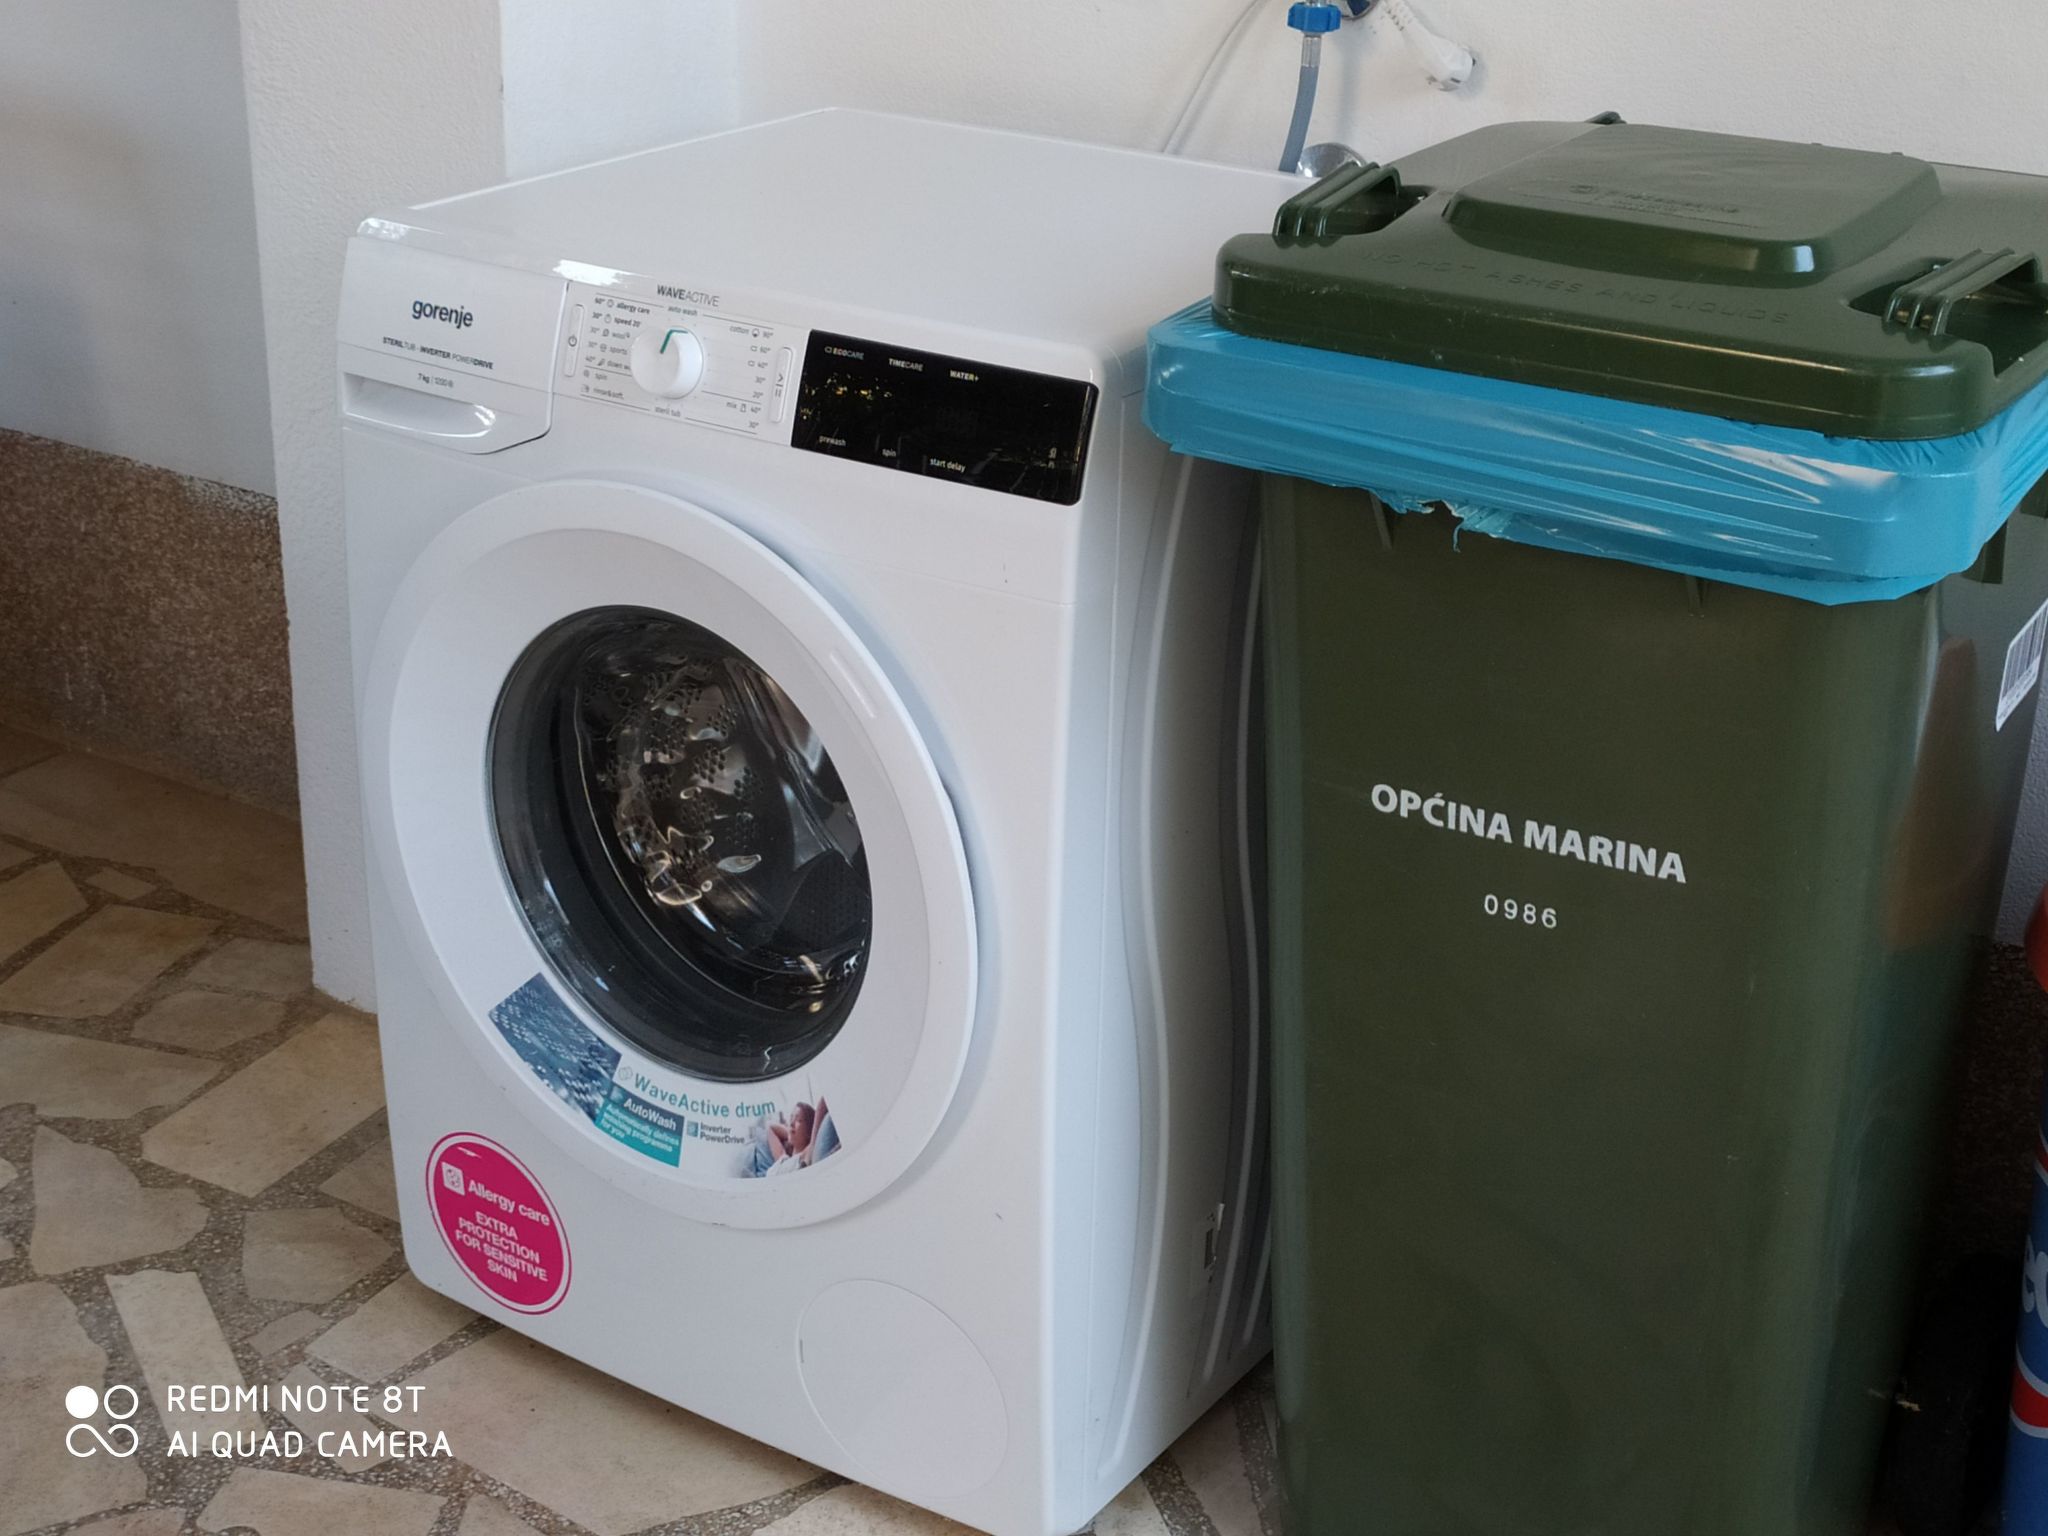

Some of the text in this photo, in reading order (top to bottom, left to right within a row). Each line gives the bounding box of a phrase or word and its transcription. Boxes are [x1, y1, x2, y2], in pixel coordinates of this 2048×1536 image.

[1483, 270, 1584, 294] ASHES
[616, 301, 637, 313] allergy
[637, 306, 651, 315] care
[656, 284, 720, 308] WAVEACTIVE
[411, 300, 474, 329] gorenje
[614, 316, 633, 326] speed
[419, 345, 452, 359] INVERTER
[929, 456, 967, 474] start delay
[1371, 783, 1687, 884] OPĆINA MARINA
[1484, 893, 1558, 929] 0986
[634, 1071, 776, 1118] WaveActive drum
[623, 1097, 677, 1131] AutoWash
[700, 1121, 732, 1135] Inverter
[700, 1132, 746, 1144] PowerDrive
[468, 1179, 551, 1227] Allergy care
[475, 1210, 518, 1241] EXTRA
[458, 1216, 541, 1265] PROTECTION
[455, 1229, 549, 1282] FOR SENSITIVE
[487, 1258, 518, 1283] SKIN
